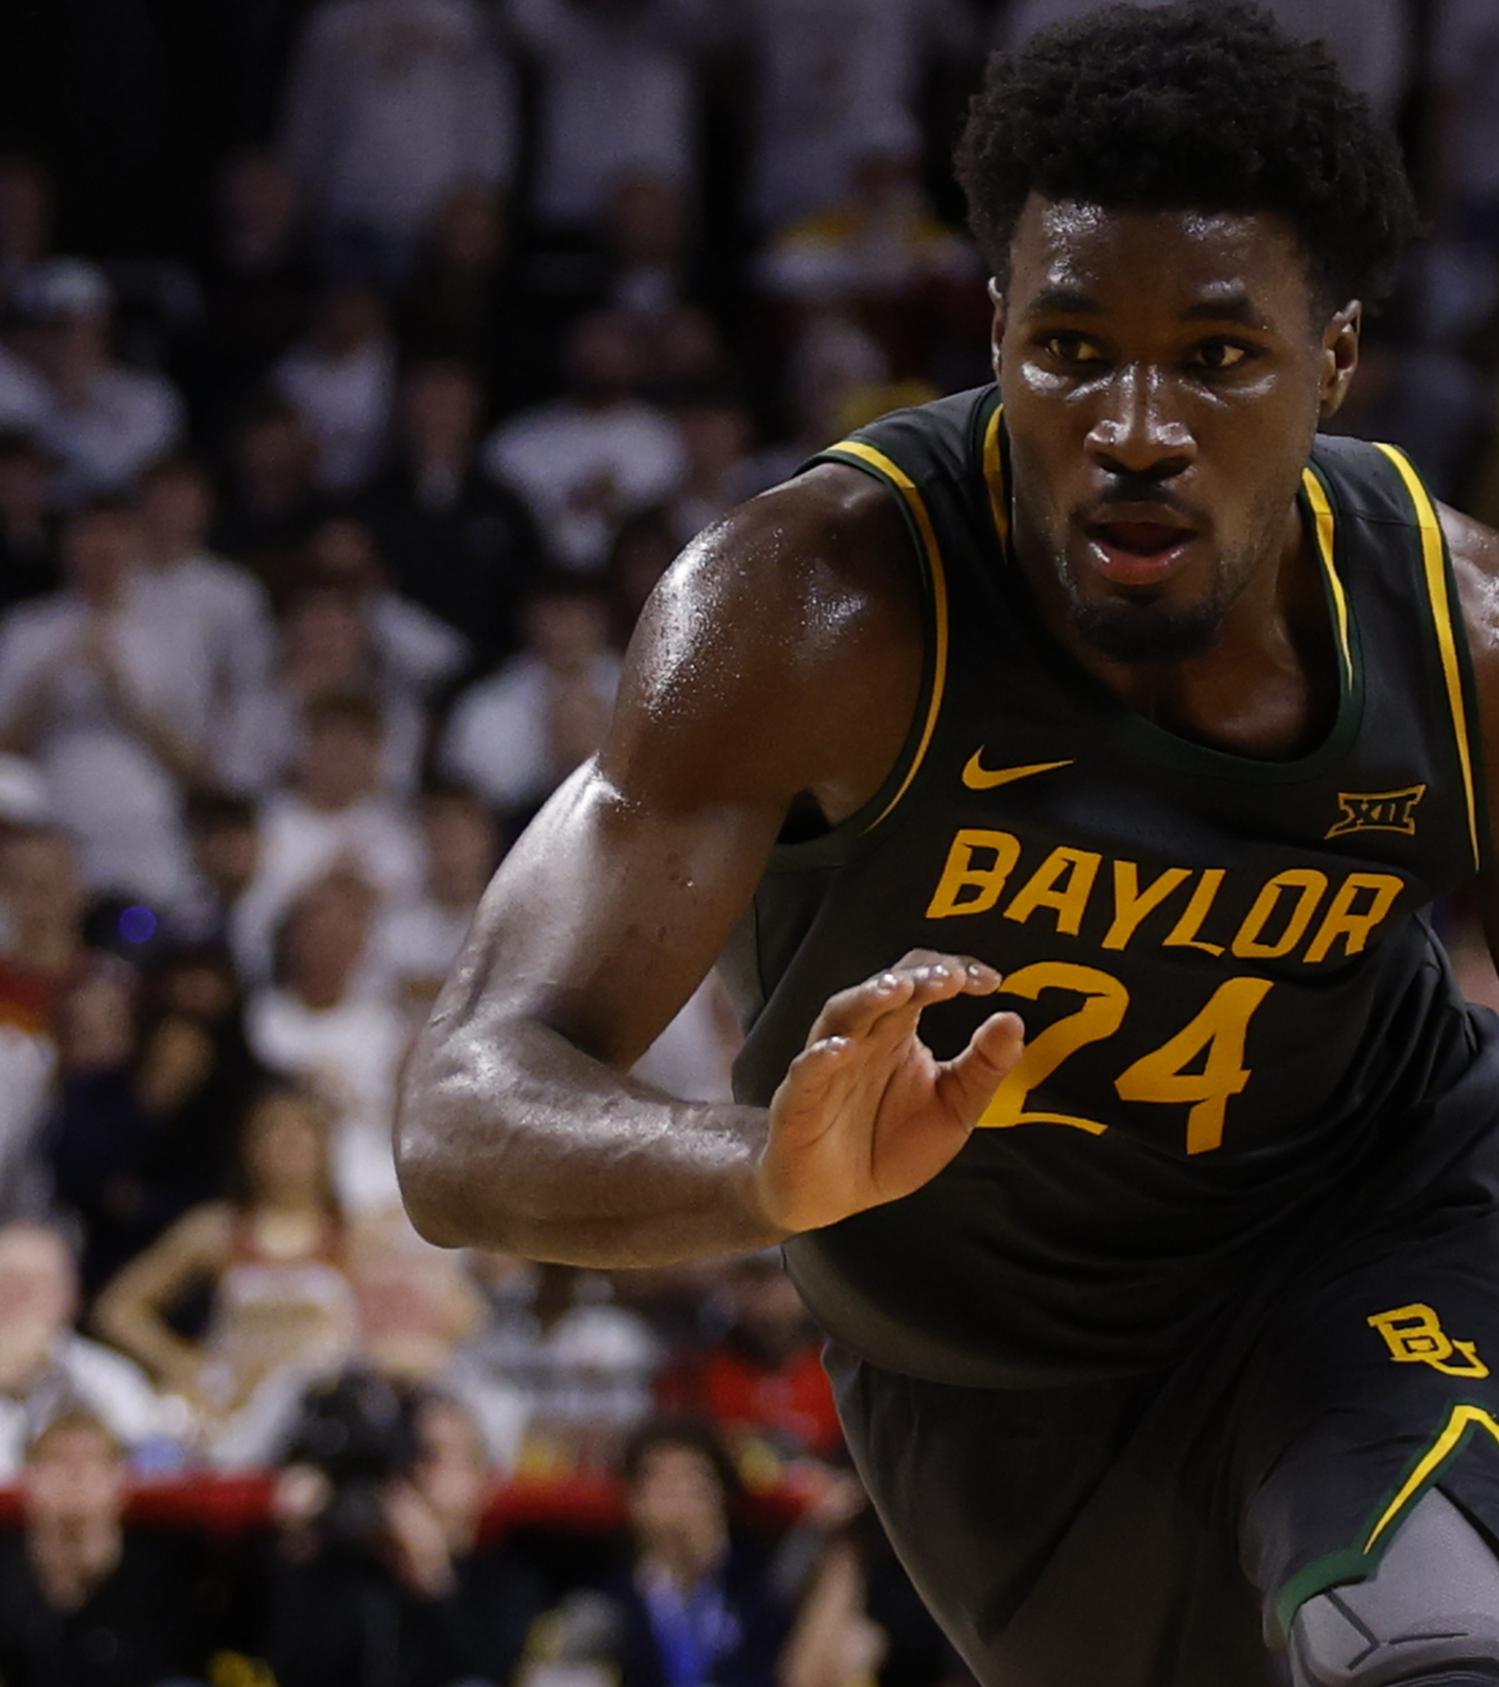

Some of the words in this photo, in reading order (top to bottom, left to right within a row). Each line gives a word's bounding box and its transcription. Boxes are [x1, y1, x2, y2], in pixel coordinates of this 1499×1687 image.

[925, 829, 1404, 963] BAYLOR
[976, 962, 1275, 1154] 24
[1367, 1302, 1490, 1379] BU
